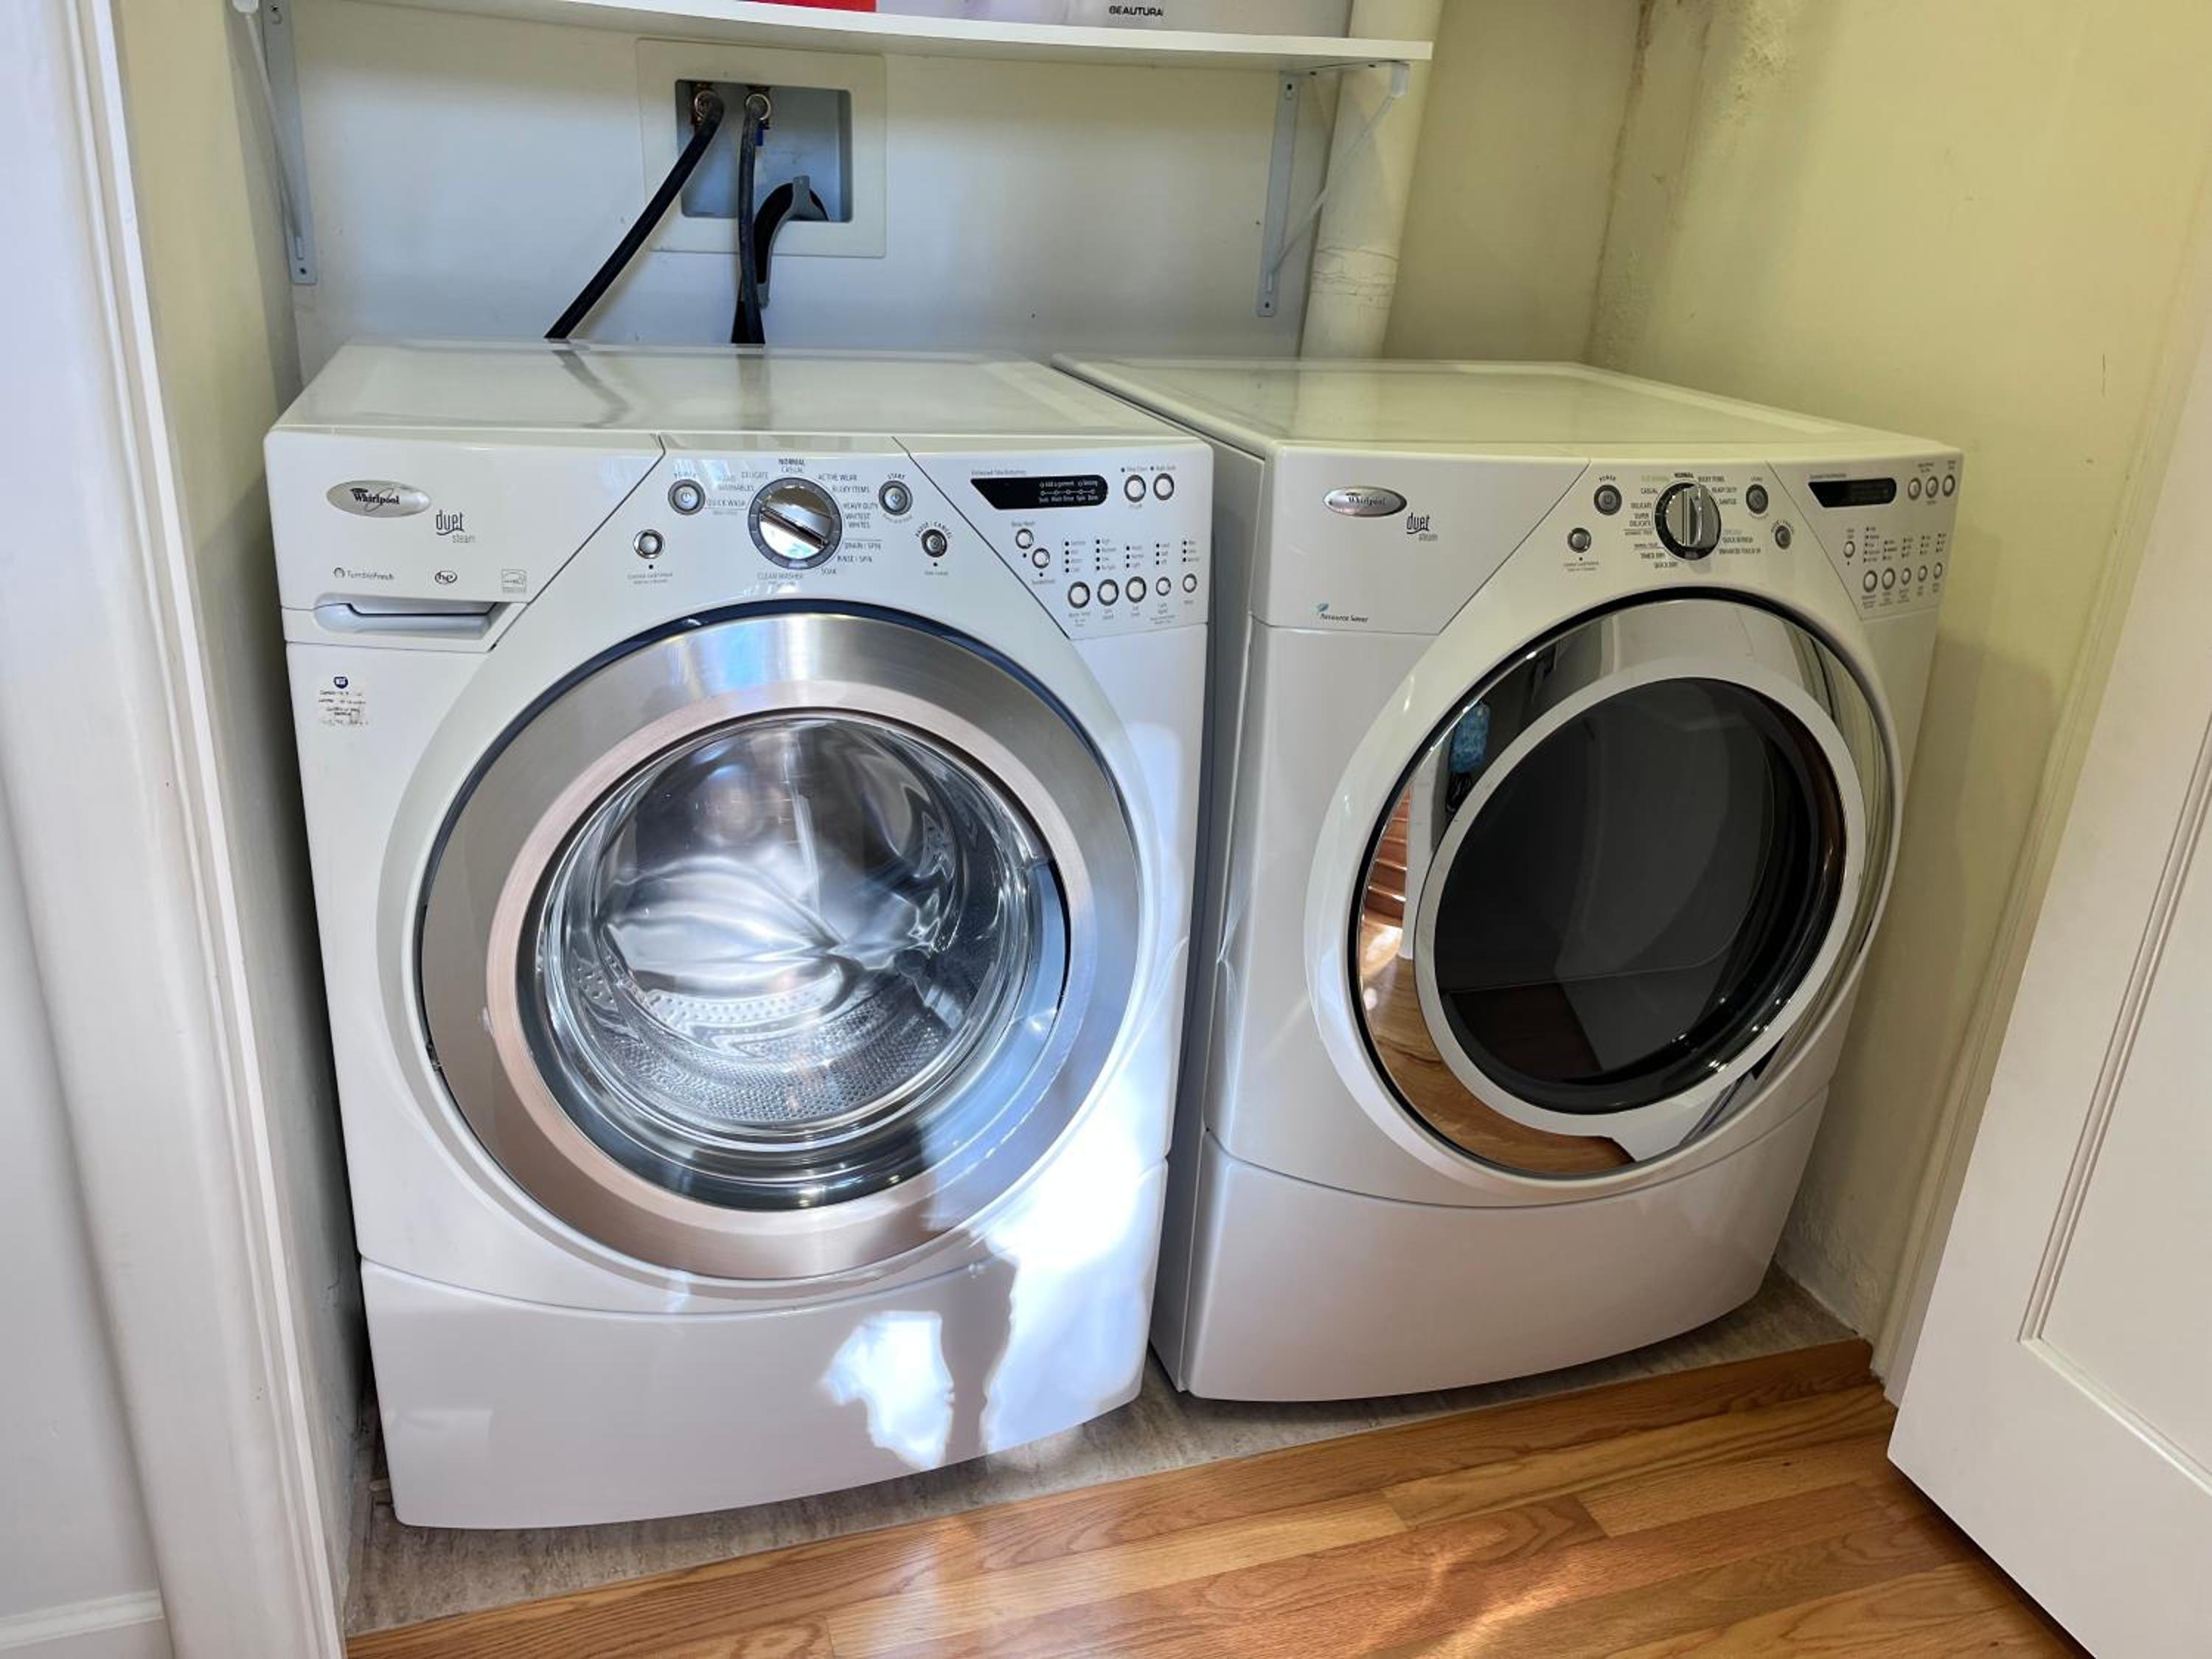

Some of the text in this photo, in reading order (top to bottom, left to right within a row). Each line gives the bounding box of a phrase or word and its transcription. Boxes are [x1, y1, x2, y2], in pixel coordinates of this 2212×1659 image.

[1109, 5, 1164, 16] BEAUTURA
[351, 490, 400, 507] Whirlpool
[1347, 495, 1386, 507] Whirlpool
[436, 509, 464, 534] duet
[1406, 512, 1430, 532] duet
